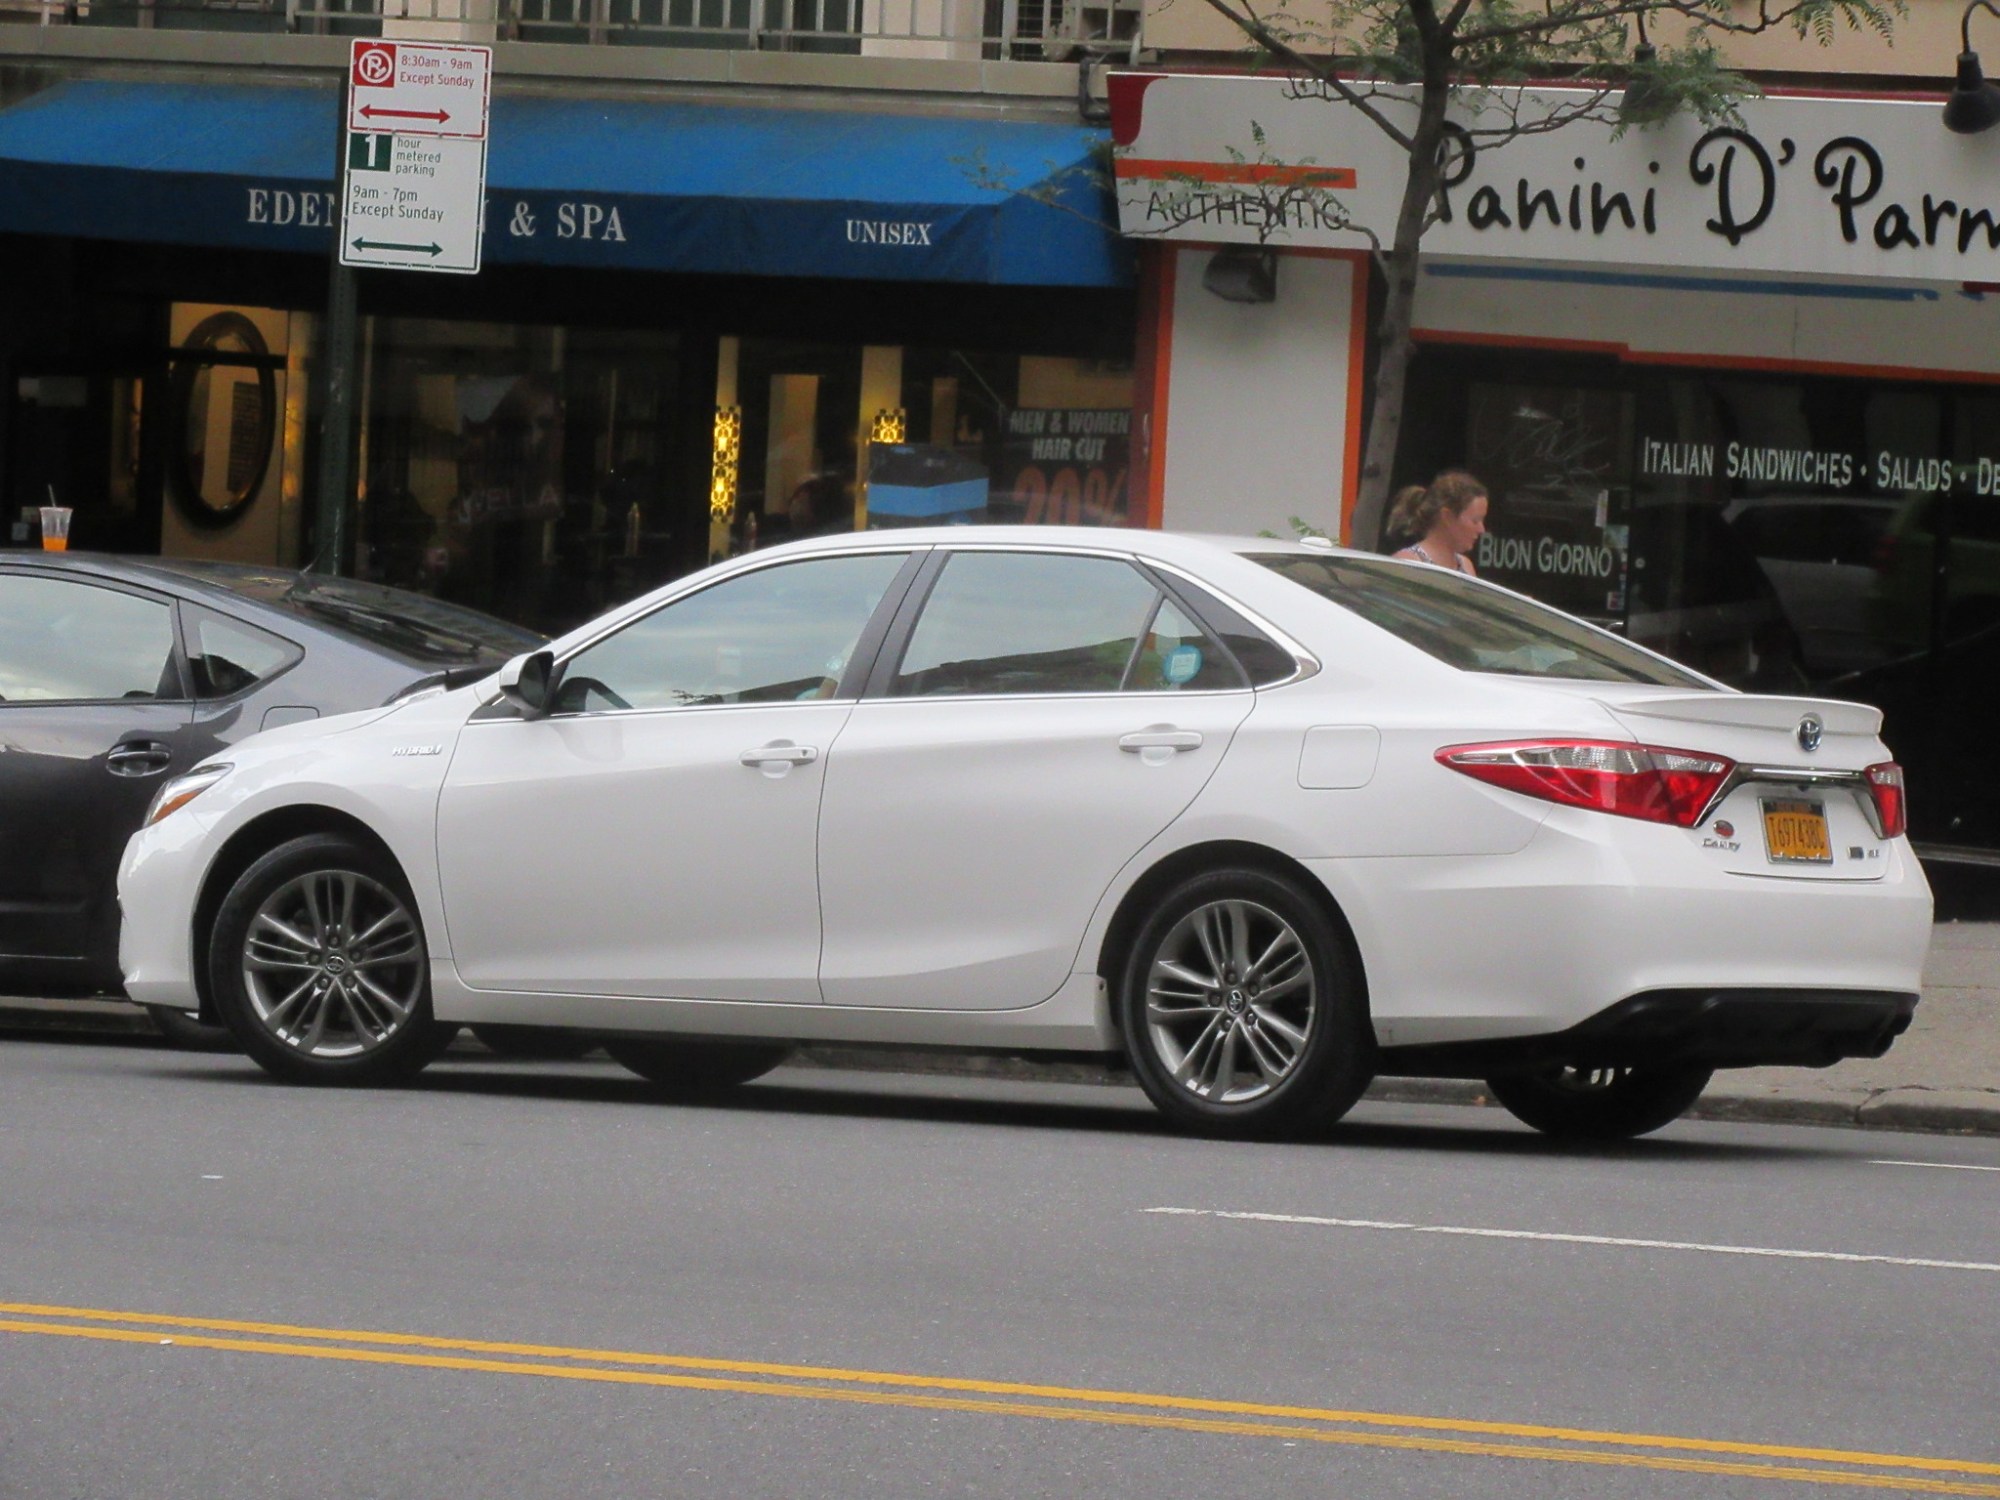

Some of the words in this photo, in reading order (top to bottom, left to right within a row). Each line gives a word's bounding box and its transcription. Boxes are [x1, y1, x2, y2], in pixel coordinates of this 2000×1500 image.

[401, 54, 440, 68] 8:30am
[450, 57, 473, 70] 9am
[400, 71, 435, 86] Except
[437, 73, 475, 90] Sunday
[365, 134, 377, 168] 1
[397, 137, 421, 148] hour
[396, 151, 442, 163] metered
[395, 164, 435, 178] parking
[353, 184, 379, 199] 9am
[393, 187, 418, 203] 7pm
[352, 202, 394, 219] Except
[398, 204, 444, 223] Sunday
[510, 201, 536, 236] &
[557, 203, 627, 242] SPA
[846, 219, 932, 246] UNISEX
[1009, 410, 1046, 433] MEN
[1068, 411, 1131, 434] WOMEN
[1032, 438, 1072, 460] HAIR
[1075, 438, 1106, 461] CUT
[1643, 436, 1715, 477] ITALIAN
[1726, 441, 1852, 487] SANDWICHES
[1877, 450, 1953, 492] SALADS
[1478, 532, 1532, 571] BUON
[1537, 536, 1613, 577] GIORNO
